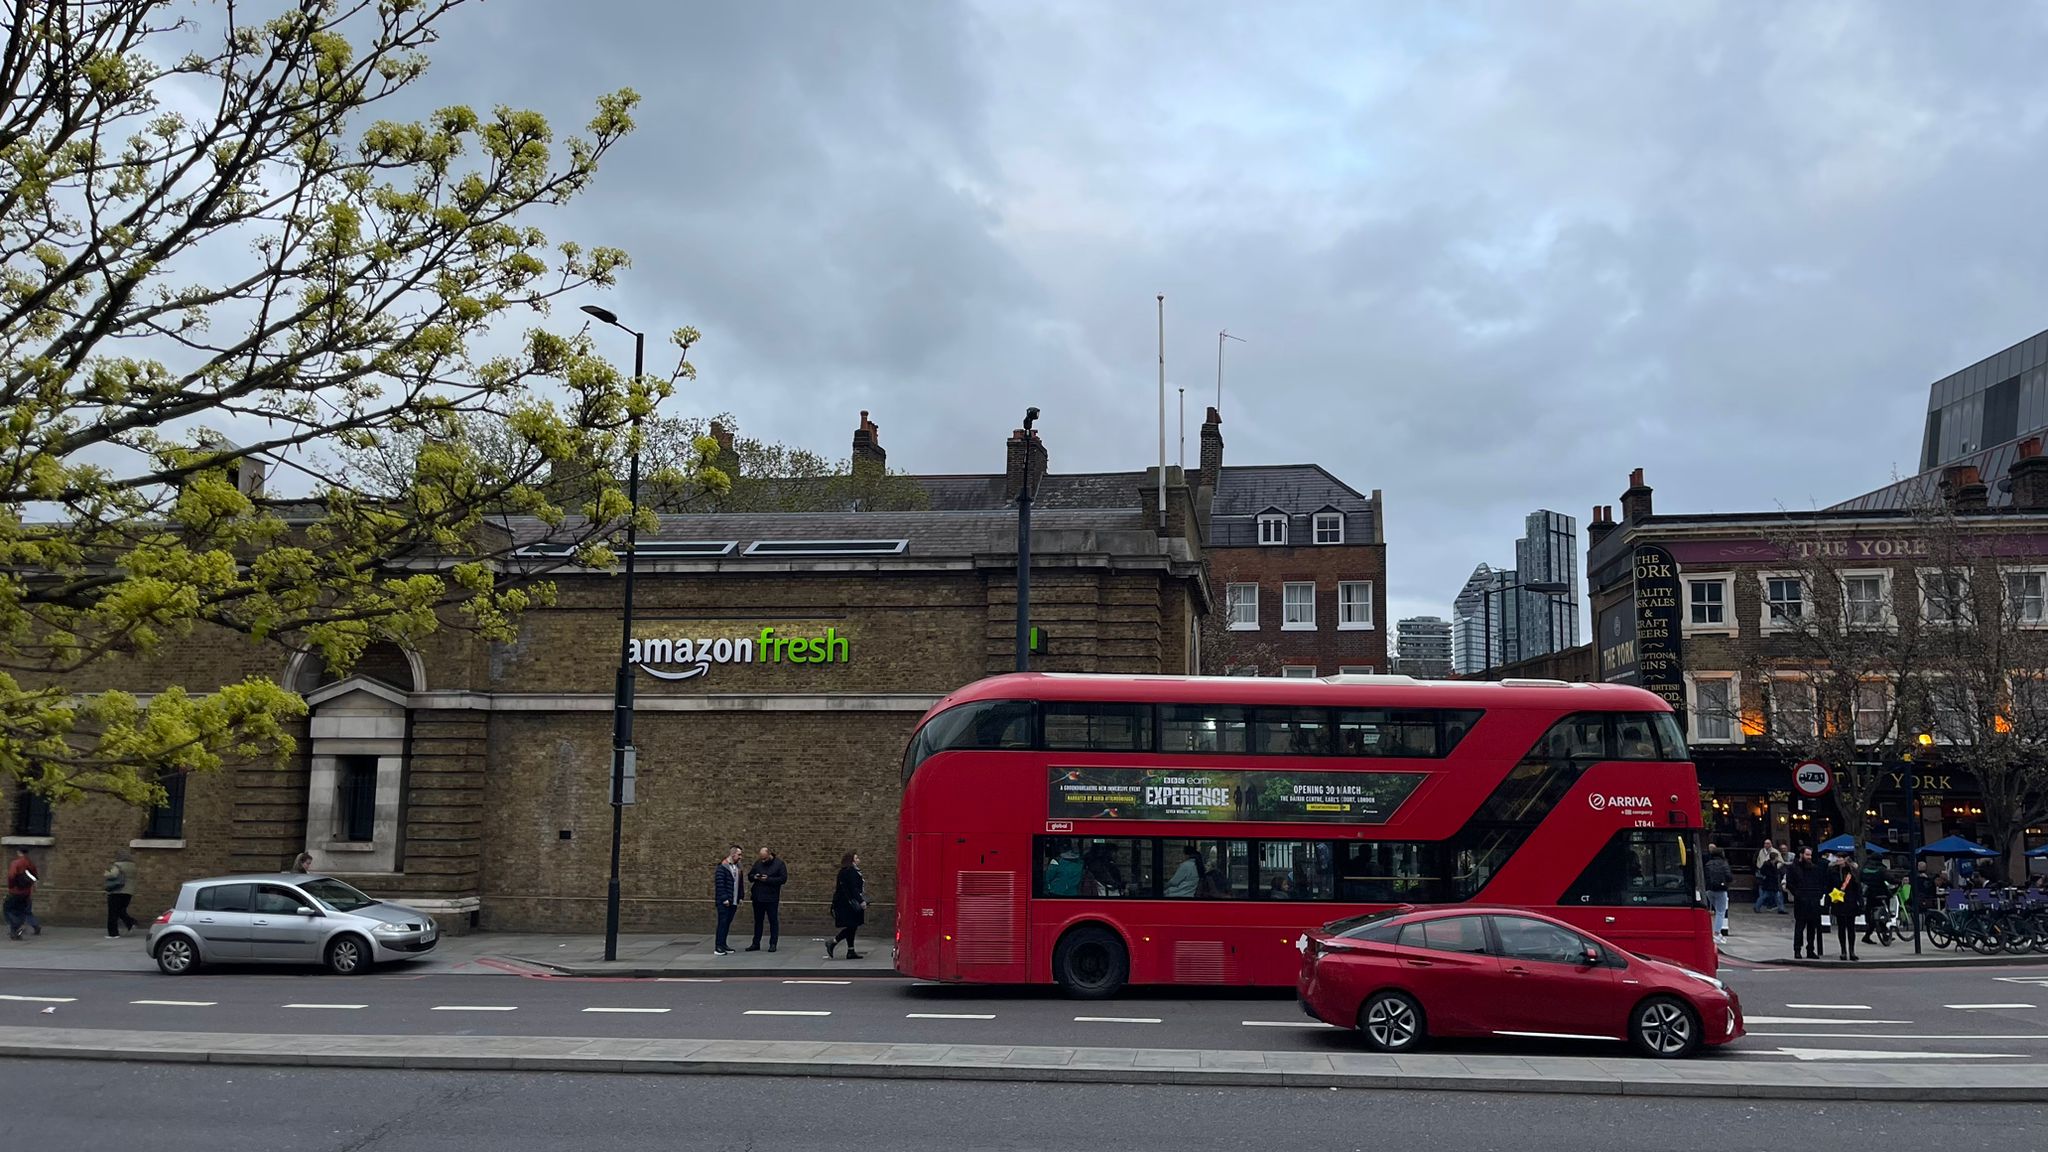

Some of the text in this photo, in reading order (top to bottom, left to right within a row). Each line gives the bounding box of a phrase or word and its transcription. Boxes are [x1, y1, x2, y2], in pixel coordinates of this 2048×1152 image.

[1797, 539, 1926, 558] THE YORK
[1636, 554, 1659, 565] THE
[1635, 564, 1672, 579] ORK
[1650, 598, 1675, 607] ALES
[1644, 609, 1653, 618] &
[629, 627, 849, 664] amazon fresh
[1603, 640, 1635, 672] THE YORK
[1640, 660, 1667, 670] GINS
[1656, 692, 1679, 701] OOD
[1890, 773, 1952, 790] YORK
[1293, 785, 1324, 795] OPENING
[1325, 786, 1335, 795] 30
[1145, 786, 1230, 806] EXPERIENCE
[1607, 796, 1652, 807] ARRIVA
